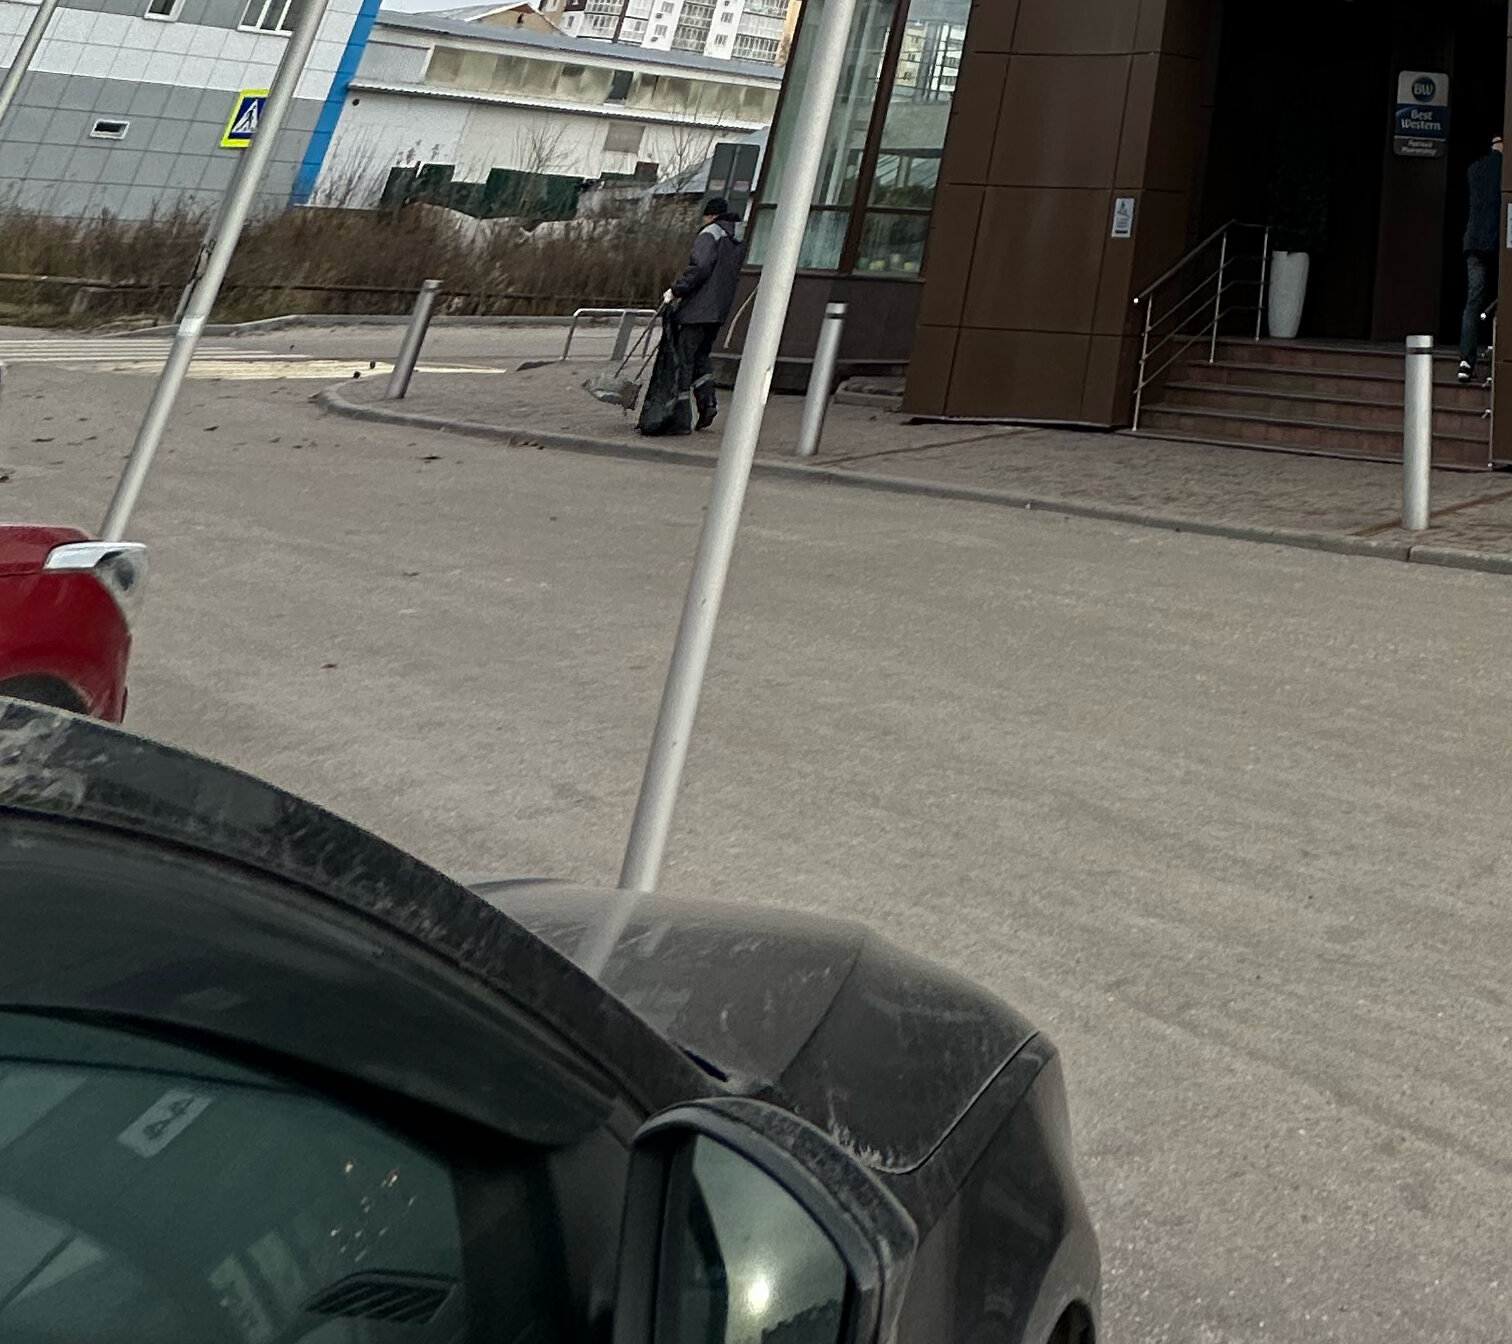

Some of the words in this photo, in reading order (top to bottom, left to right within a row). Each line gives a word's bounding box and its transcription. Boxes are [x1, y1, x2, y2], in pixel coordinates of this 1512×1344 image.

[1413, 82, 1434, 96] BW
[1411, 109, 1433, 121] Best
[1401, 118, 1441, 131] Western
